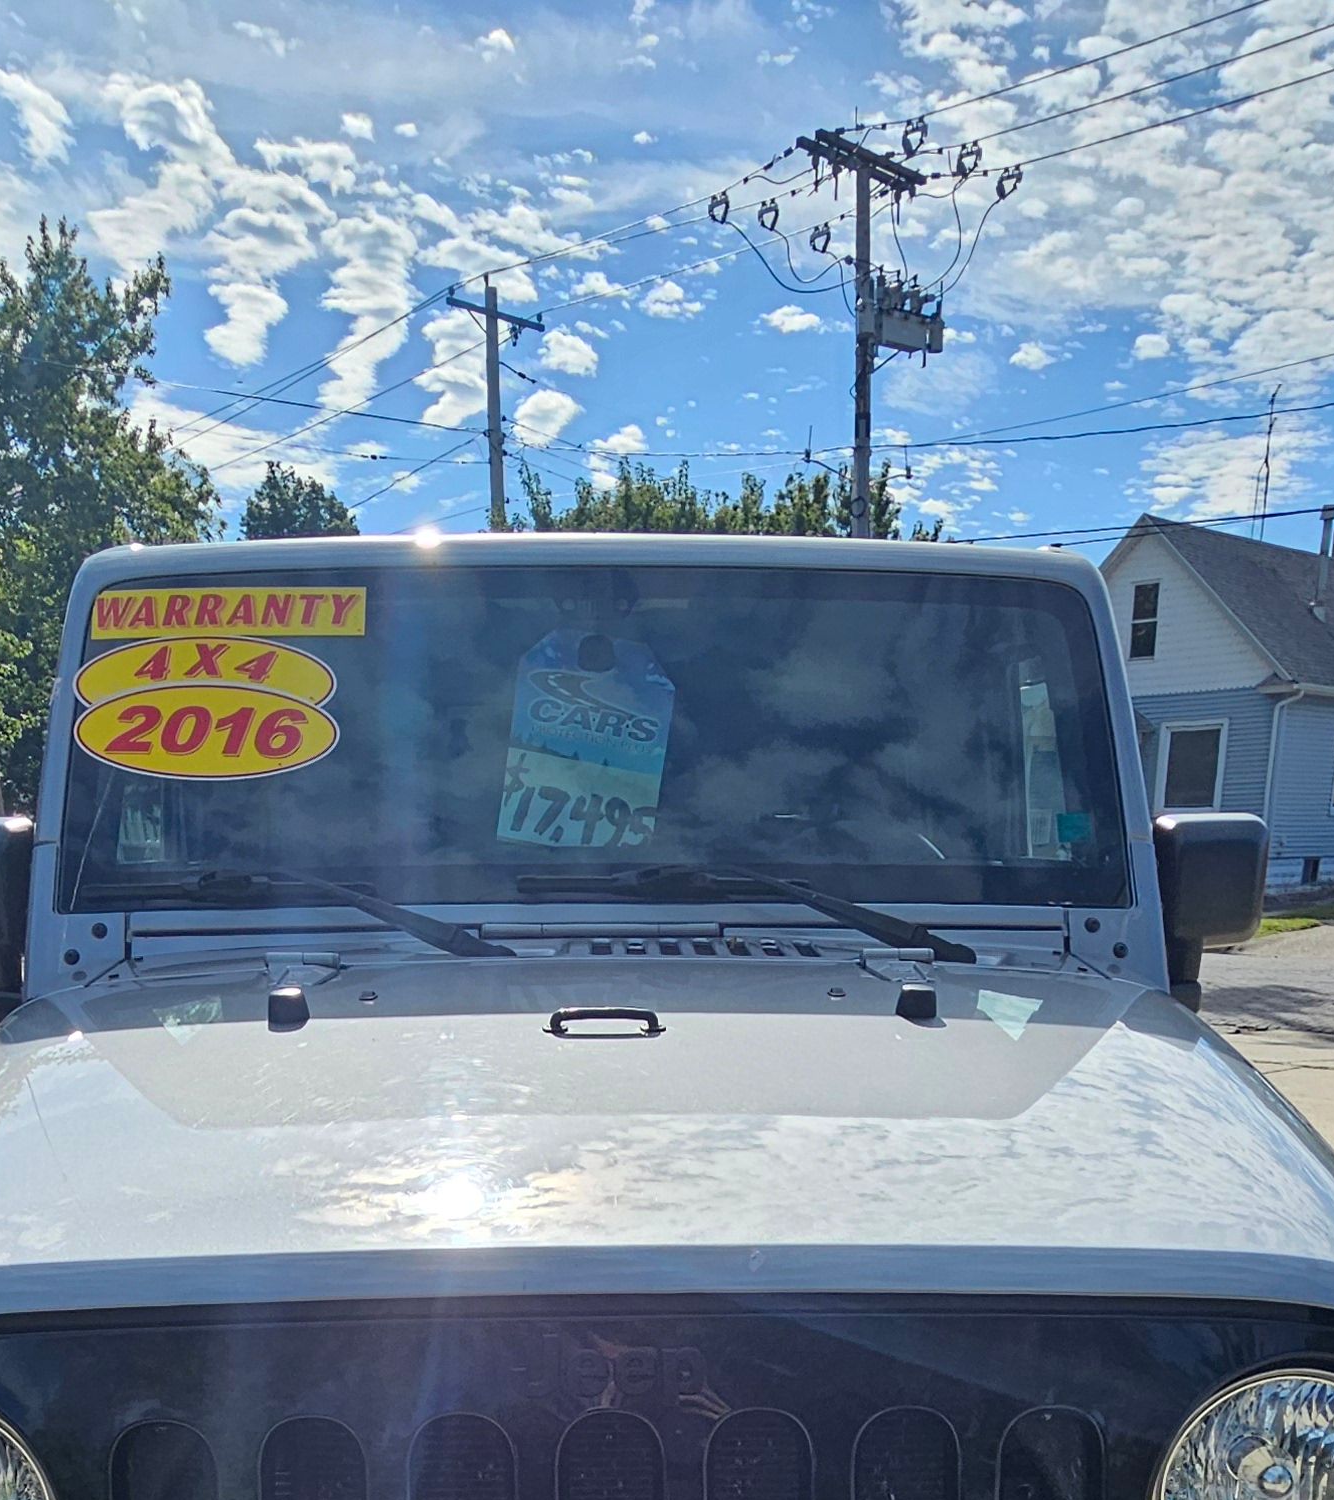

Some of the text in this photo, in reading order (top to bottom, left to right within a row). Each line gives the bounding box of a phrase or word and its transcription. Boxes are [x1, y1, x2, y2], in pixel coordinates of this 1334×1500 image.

[95, 593, 359, 631] WARRANTY
[104, 704, 309, 759] 2016
[529, 698, 659, 742] CARS
[532, 723, 616, 746] PROTETION
[502, 752, 658, 849] $17,495
[511, 1331, 707, 1403] Jeep
